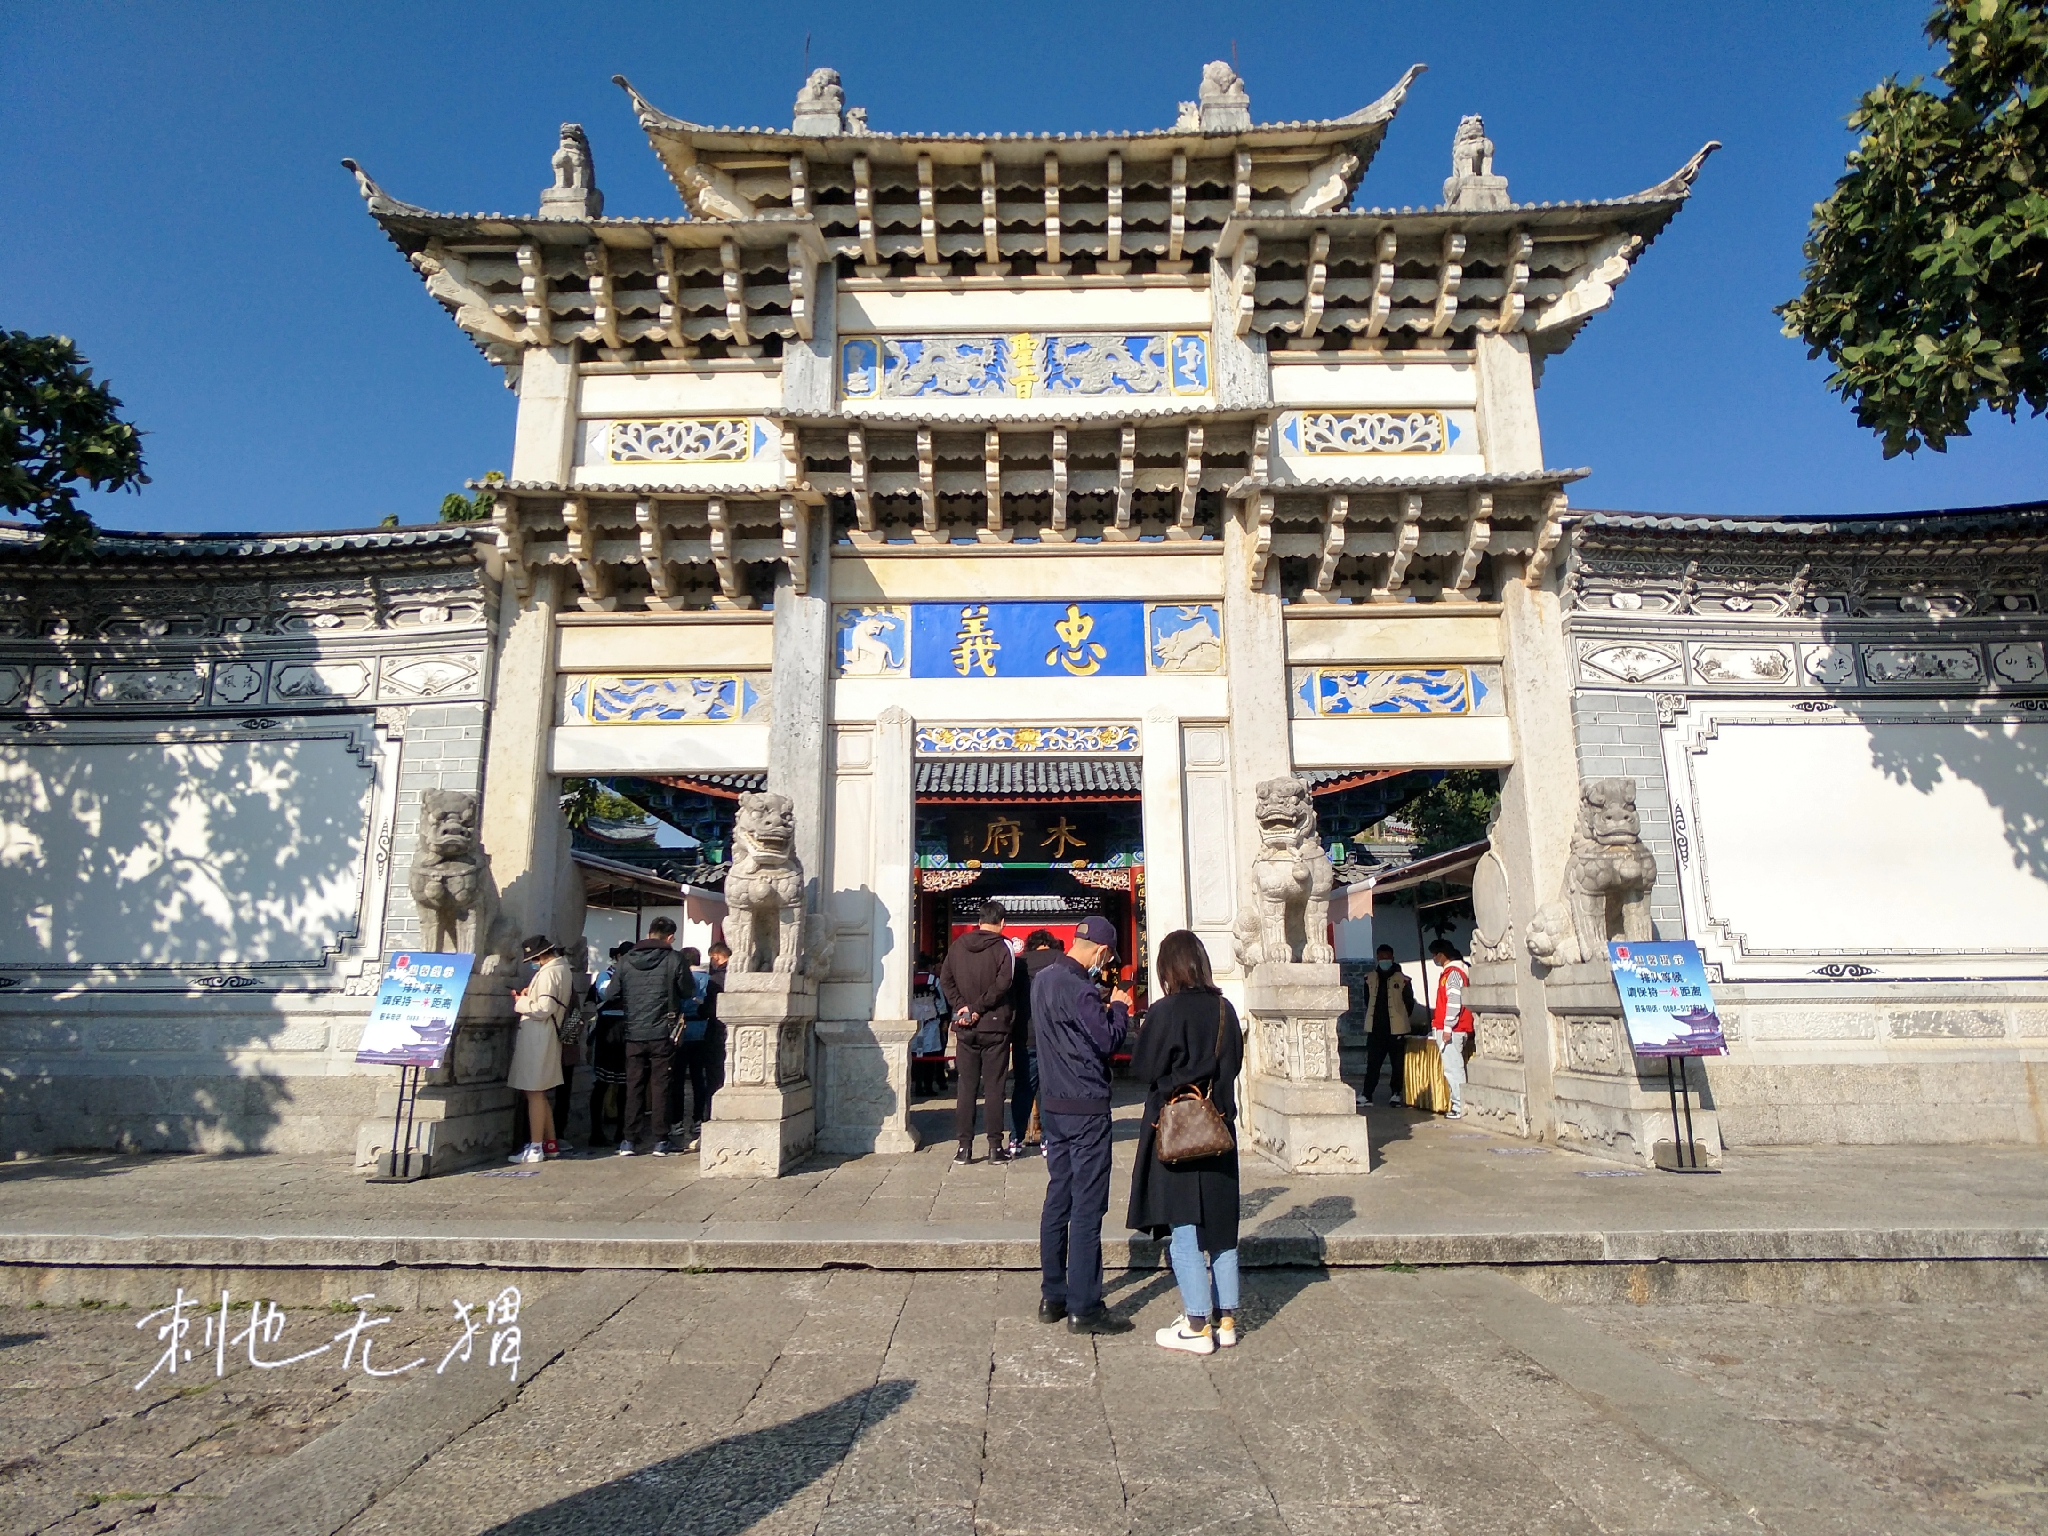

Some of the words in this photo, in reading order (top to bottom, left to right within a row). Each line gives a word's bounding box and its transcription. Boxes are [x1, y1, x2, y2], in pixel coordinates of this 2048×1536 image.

[1627, 986, 1702, 998] 请保持一米距离
[381, 996, 453, 1009] 请保持一米距离
